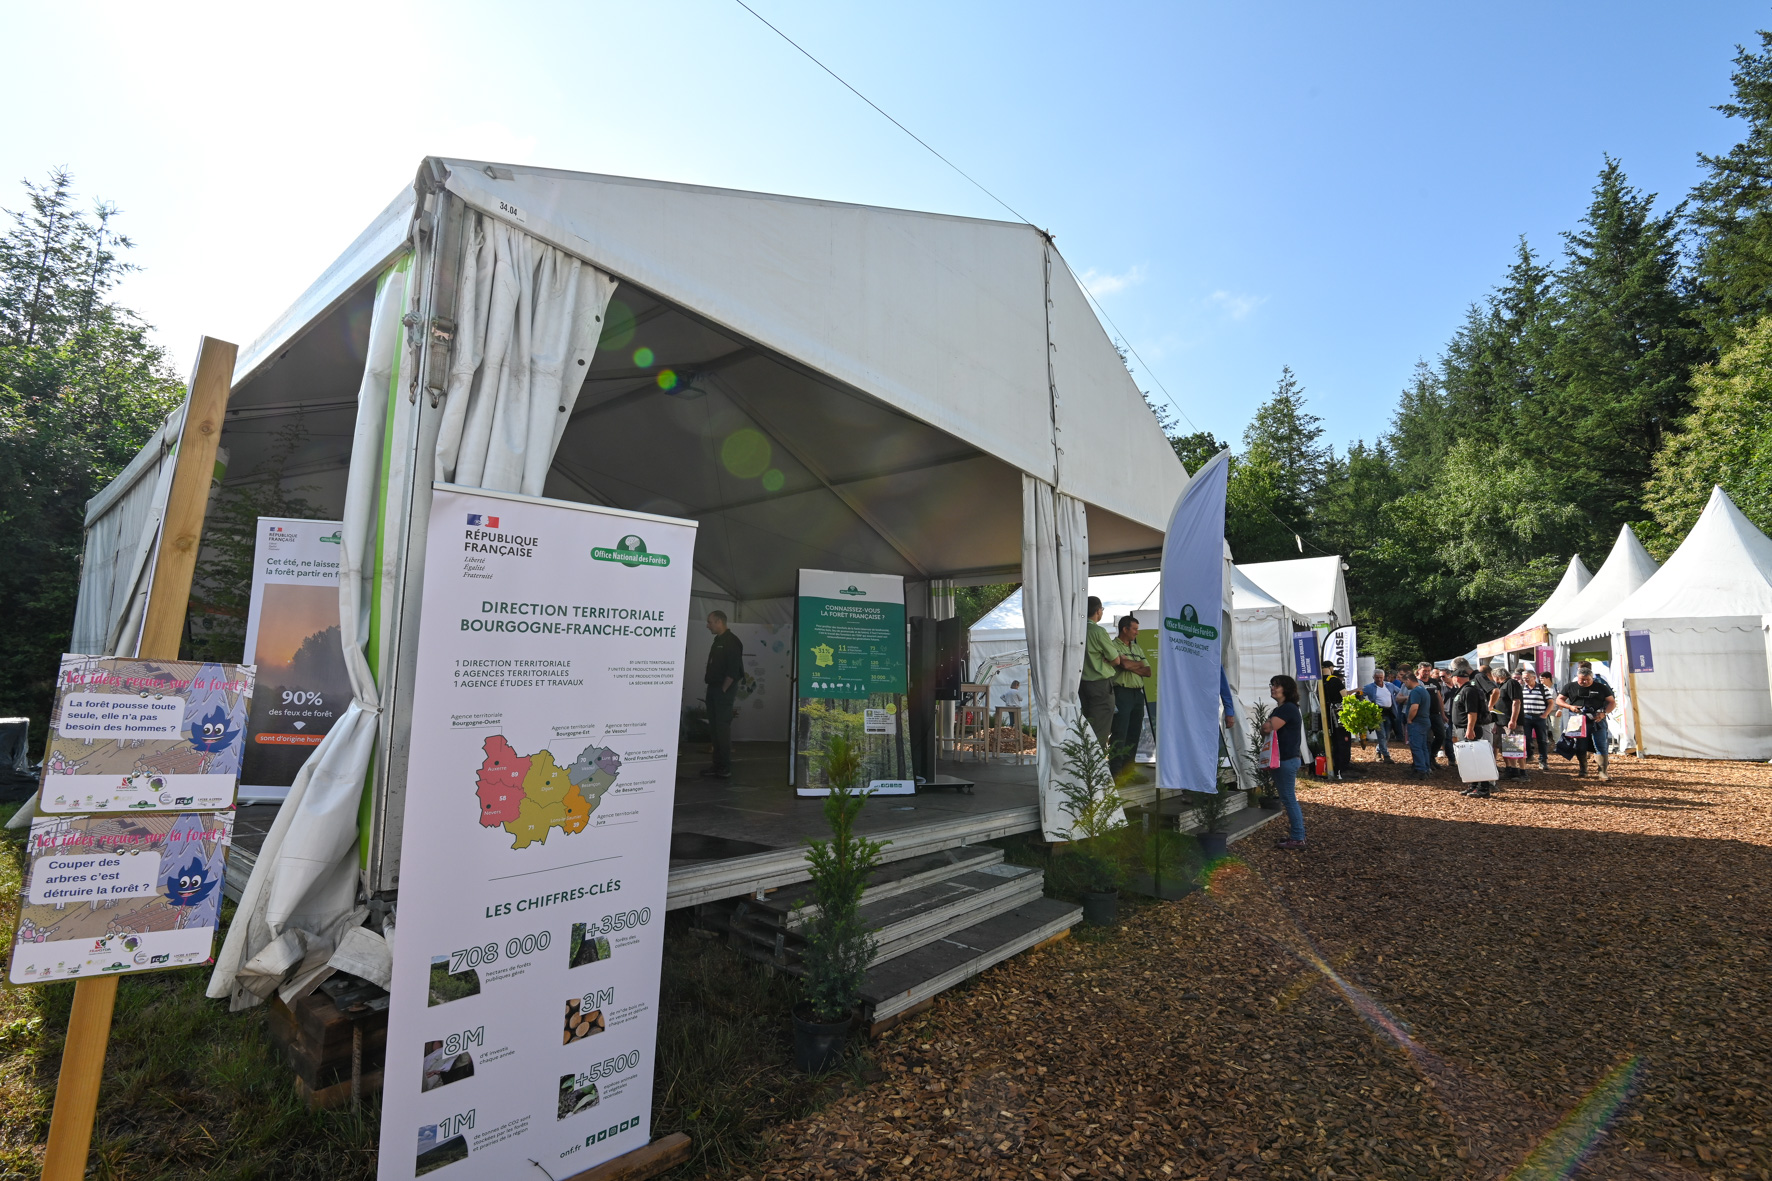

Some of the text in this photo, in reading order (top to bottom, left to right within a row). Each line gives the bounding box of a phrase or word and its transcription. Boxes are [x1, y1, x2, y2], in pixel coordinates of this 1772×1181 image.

[500, 202, 517, 216] 34.04
[465, 529, 538, 547] RÉPUBLIQUE
[464, 542, 533, 557] FRANÇAISE
[594, 550, 612, 558] Office
[612, 552, 638, 562] National
[649, 556, 666, 564] Forêts
[283, 559, 299, 567] été,
[314, 560, 340, 568] laissez
[463, 563, 486, 572] Égalité
[481, 600, 664, 622] DIRECTION TERRITORIALE
[825, 604, 880, 613] CONNAISSEZ-VOUS
[460, 619, 676, 638] BOURGOGNE-FRANCHE-COMTÉ
[1178, 622, 1193, 632] National
[1200, 627, 1214, 638] Forêts
[1335, 632, 1345, 673] NDAISE
[66, 670, 85, 685] Les
[91, 672, 120, 686] idées
[126, 677, 164, 690] reçues
[170, 678, 189, 689] sur
[194, 678, 204, 689] la
[209, 678, 243, 691] forêt
[462, 670, 505, 678] AGENCES
[460, 680, 498, 688] AGENCE
[500, 678, 533, 687] ÉTUDES
[86, 700, 110, 708] forêt
[112, 702, 149, 711] pousse
[282, 690, 323, 706] 90%
[67, 712, 98, 720] seule,
[452, 719, 500, 727] Bourgogne-Ouest
[277, 735, 305, 743] d'origine
[37, 834, 56, 848] Les
[62, 833, 93, 847] idées
[100, 832, 139, 848] reçues
[145, 832, 166, 844] sur
[170, 829, 181, 842] la
[186, 828, 218, 842] forêt
[49, 858, 120, 870] Couper des
[46, 872, 120, 884] arbres c'est
[43, 886, 93, 898] détruire
[111, 884, 139, 894] forêt
[486, 879, 621, 918] LES CHIFFRES-CLÉS
[586, 906, 651, 938] +3500
[614, 938, 640, 948] collectivités
[450, 930, 552, 972] 708 000
[485, 969, 525, 983] publiques gérés
[486, 962, 531, 977] hectares forêts
[581, 986, 614, 1012] 3M
[444, 1026, 484, 1056] 8M
[479, 1050, 515, 1065] chaque année
[490, 1046, 508, 1056] investis
[576, 1049, 640, 1087] +5500
[439, 1108, 476, 1139] 1M
[482, 1127, 500, 1136] tonnes
[508, 1118, 520, 1127] CO2
[473, 1135, 496, 1146] stockées
[514, 1121, 528, 1132] forêts
[480, 1127, 528, 1150] prairies région
[560, 1144, 581, 1159] onf.fr
